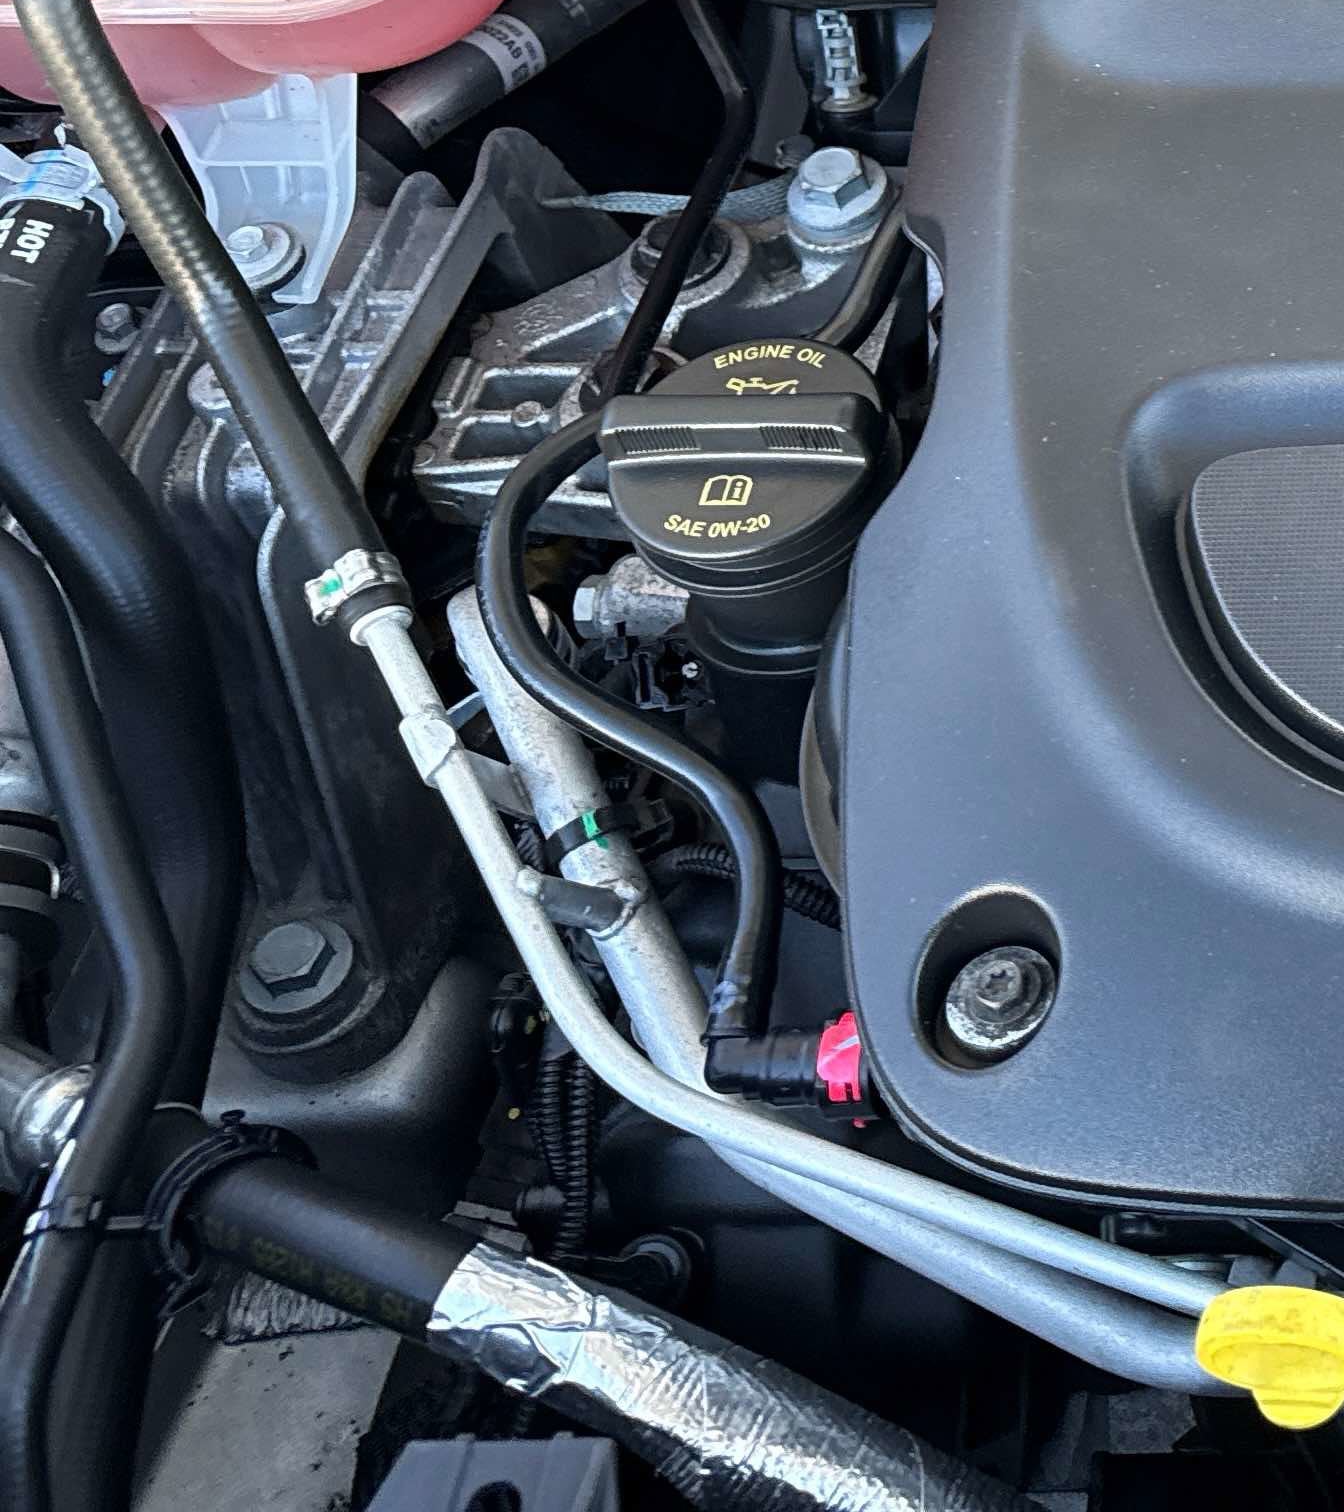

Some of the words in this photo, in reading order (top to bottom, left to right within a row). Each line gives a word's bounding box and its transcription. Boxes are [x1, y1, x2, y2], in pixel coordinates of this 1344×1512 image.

[10, 219, 55, 264] HOT
[713, 344, 796, 370] ENGINE
[796, 347, 827, 369] OIL
[663, 514, 705, 538] SAE
[707, 513, 771, 538] 0W-20
